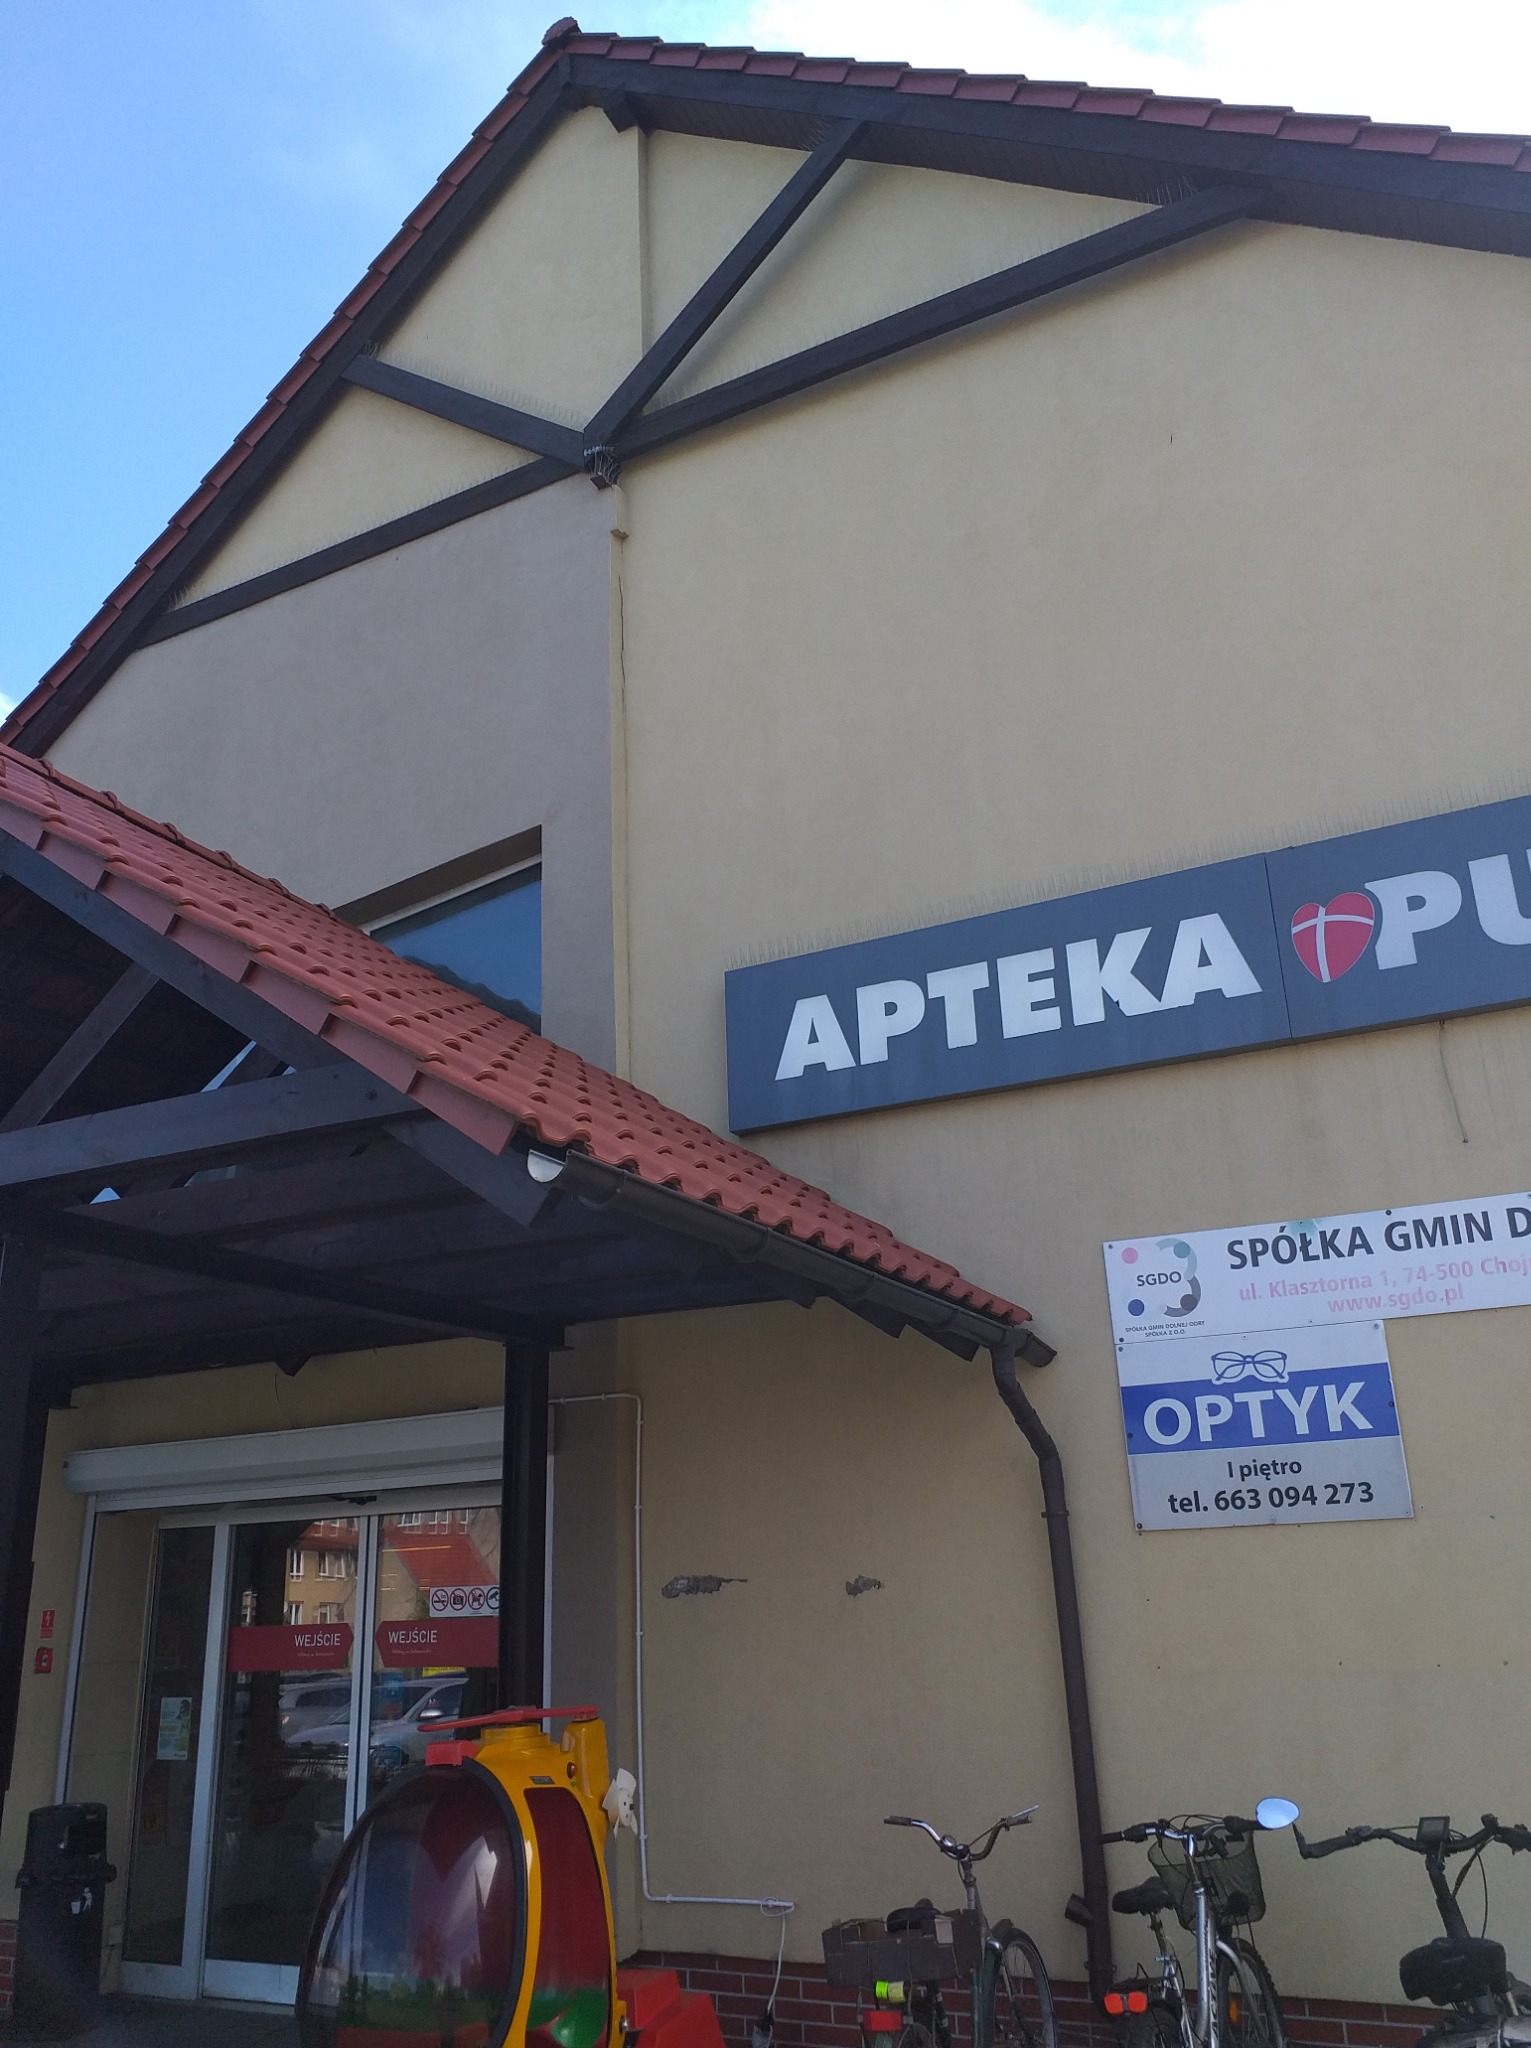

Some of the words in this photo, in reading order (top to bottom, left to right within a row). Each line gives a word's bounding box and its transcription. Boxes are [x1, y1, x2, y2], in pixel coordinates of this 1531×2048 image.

[775, 913, 1262, 1081] APTEKA
[1227, 1225, 1375, 1270] SPÓŁKA
[1384, 1211, 1493, 1252] GMIN
[1136, 1271, 1182, 1287] SGDO
[1240, 1282, 1262, 1301] ul.
[1269, 1275, 1373, 1298] Klasztorna
[1380, 1270, 1397, 1288] 1,
[1402, 1260, 1474, 1285] 74-500
[1480, 1254, 1531, 1277] Choj
[1327, 1281, 1464, 1313] www.sgdo.pl
[1165, 1321, 1188, 1329] DOLNEJ
[1143, 1381, 1374, 1446] OPTYK
[1239, 1458, 1302, 1482] piętro
[1167, 1490, 1209, 1513] tel.
[1214, 1488, 1262, 1511] 663
[1268, 1485, 1318, 1508] 094
[1323, 1481, 1374, 1505] 273
[294, 1630, 341, 1647] WEJŚCIE
[388, 1627, 438, 1644] WEJŚCIE
